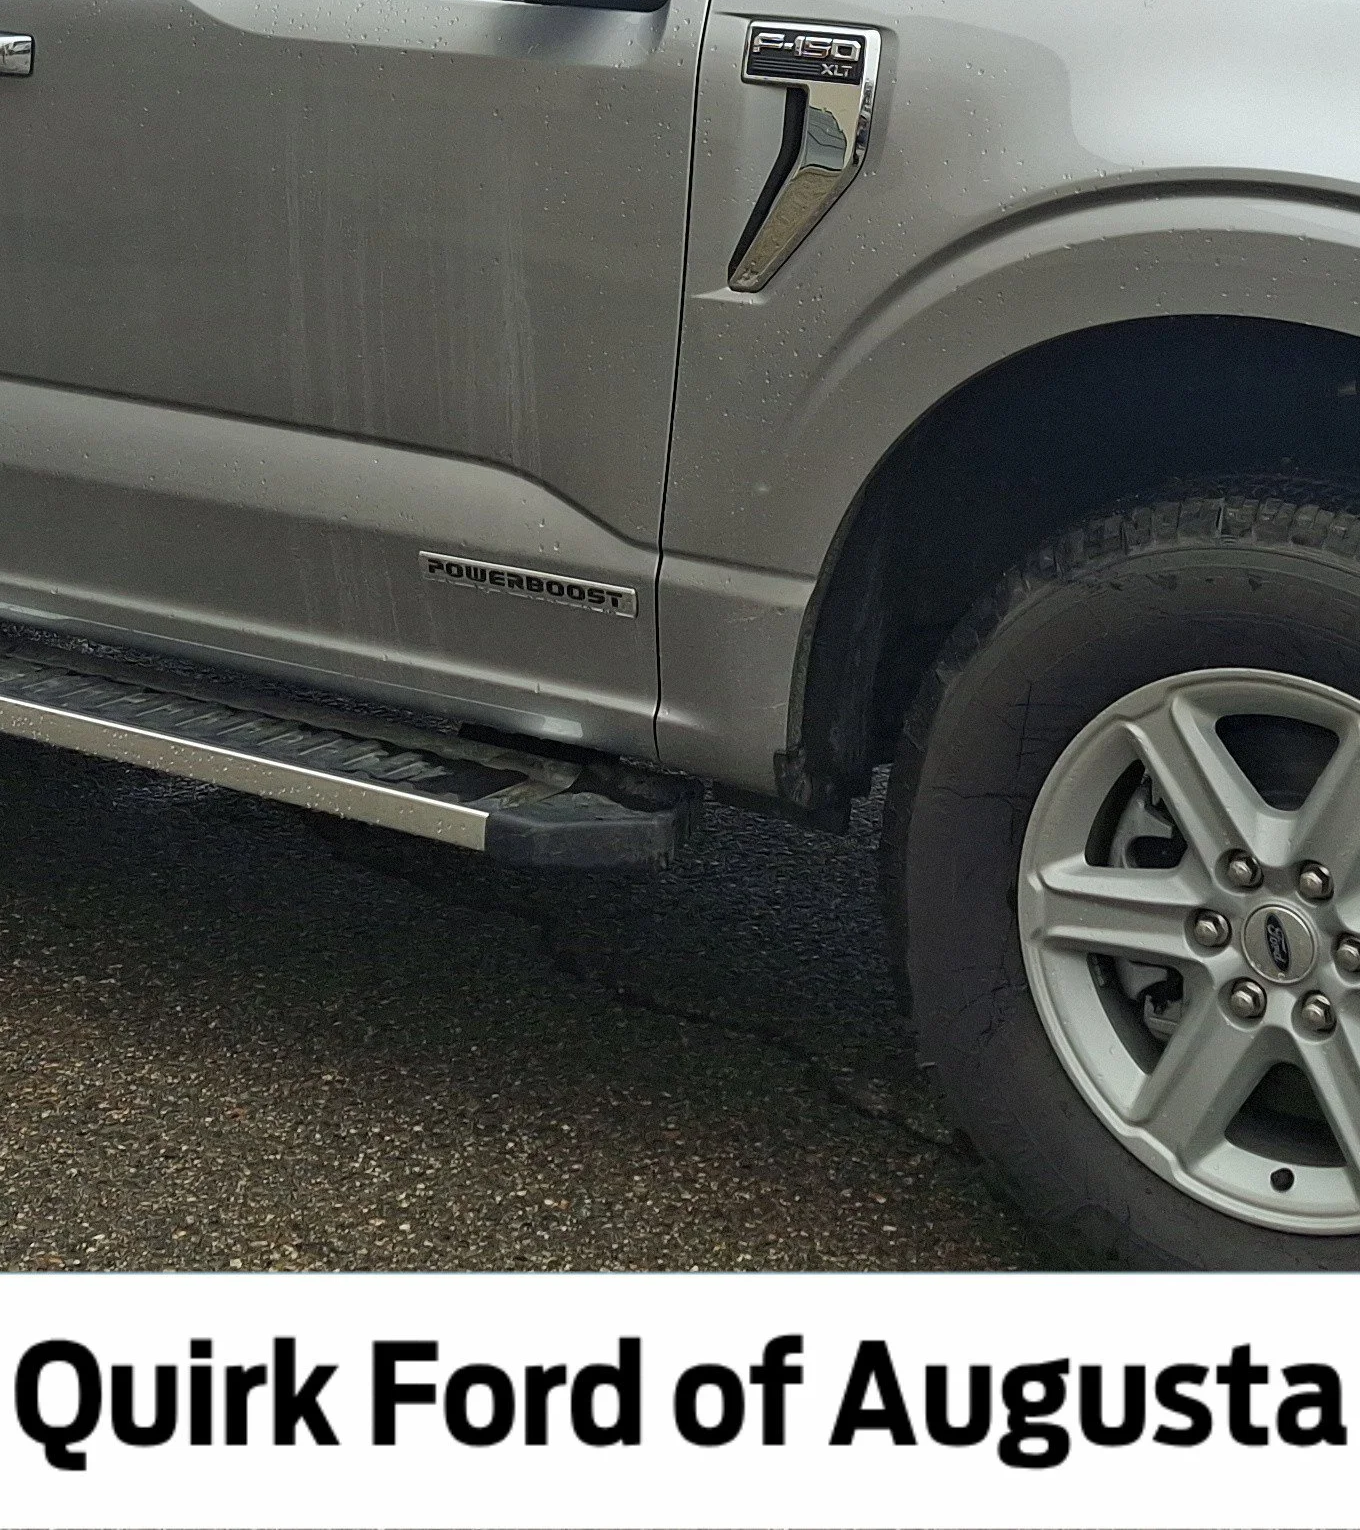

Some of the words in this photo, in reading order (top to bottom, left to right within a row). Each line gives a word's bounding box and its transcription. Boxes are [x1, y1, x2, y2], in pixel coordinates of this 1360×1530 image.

[752, 32, 862, 63] F-150
[820, 63, 853, 78] XLT
[427, 557, 624, 609] POWERBOOST
[1267, 923, 1288, 965] Ford
